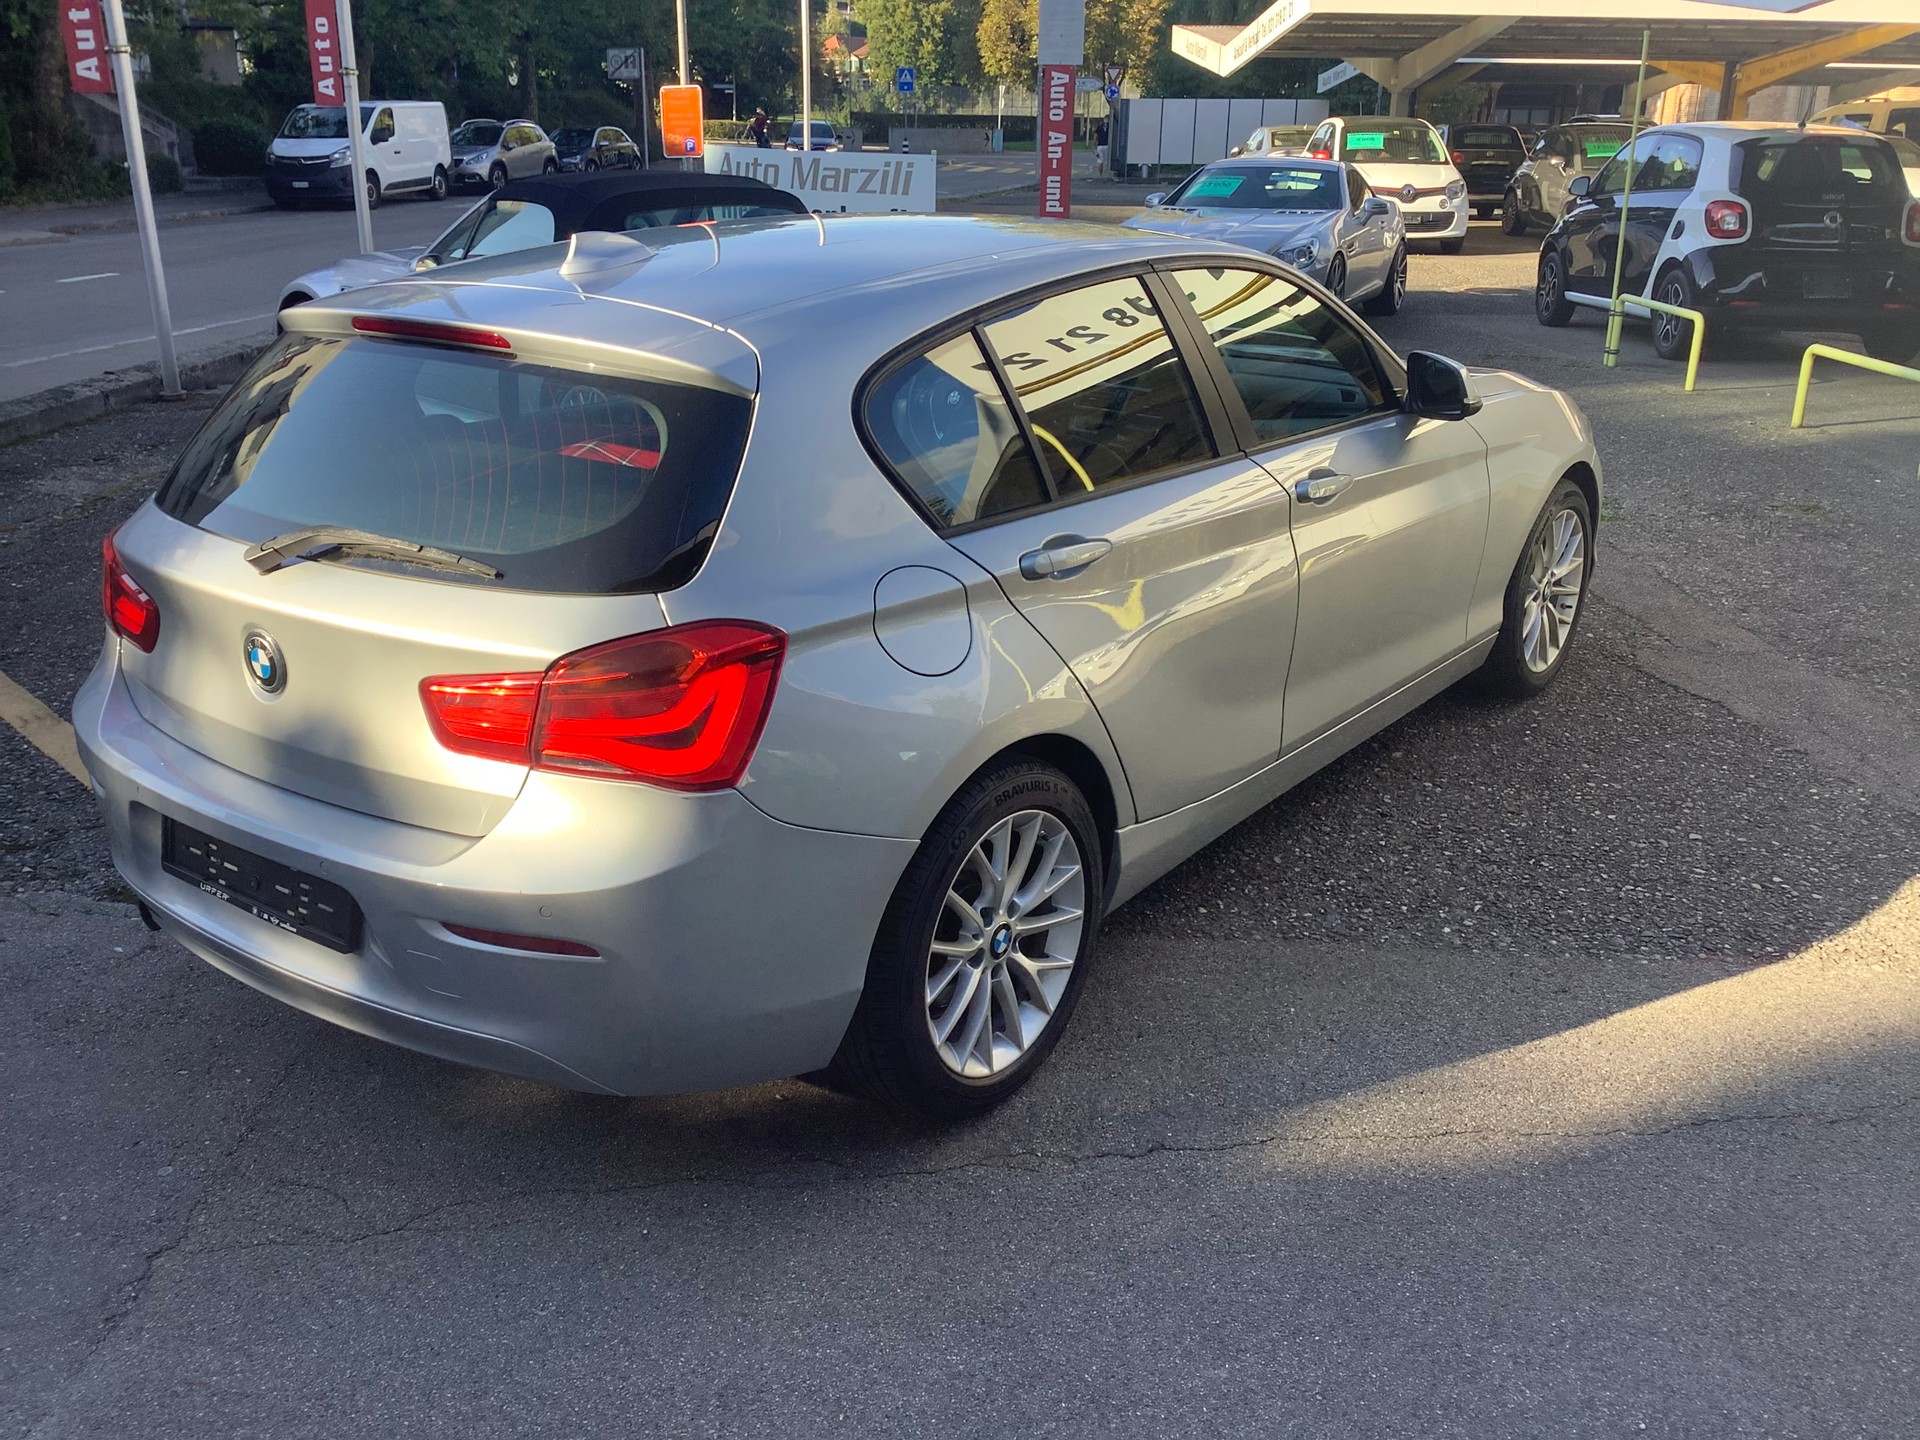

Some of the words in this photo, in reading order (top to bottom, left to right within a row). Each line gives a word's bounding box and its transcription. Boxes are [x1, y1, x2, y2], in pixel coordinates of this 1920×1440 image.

[315, 16, 335, 96] Auto
[1049, 70, 1070, 122] Auto
[1047, 131, 1067, 169] An-
[719, 151, 780, 188] Auto
[790, 156, 915, 197] Marzili
[1045, 175, 1064, 213] und
[994, 780, 1051, 808] BRAVURIS
